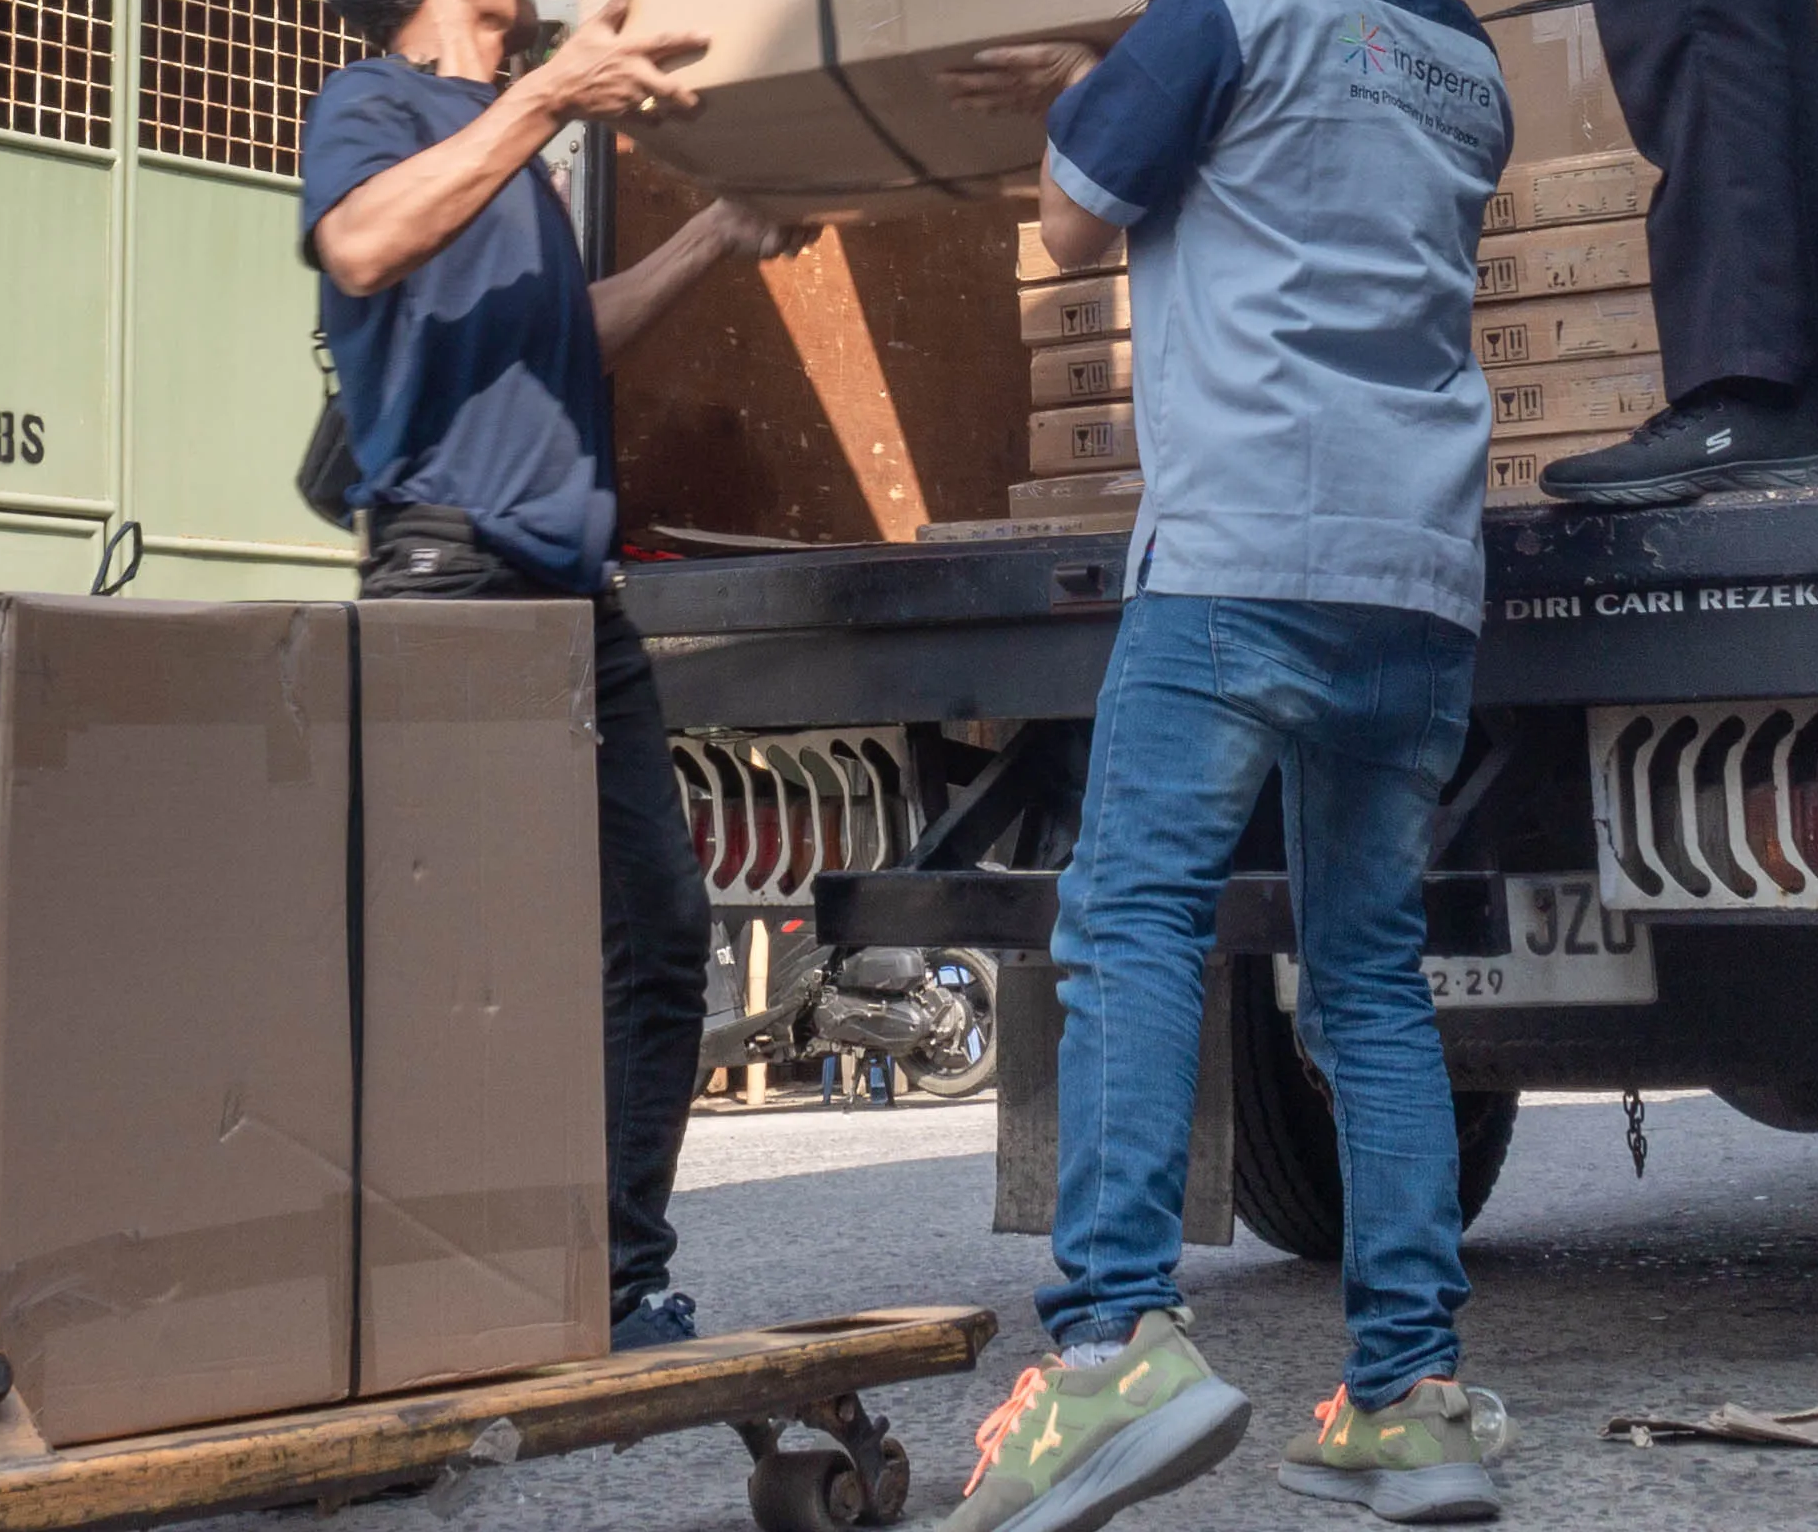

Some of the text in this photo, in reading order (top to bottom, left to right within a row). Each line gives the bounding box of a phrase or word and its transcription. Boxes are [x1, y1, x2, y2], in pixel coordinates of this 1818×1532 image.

[1392, 41, 1490, 108] insperra
[1350, 84, 1379, 105] Bring
[1505, 597, 1580, 622] DIRI
[1594, 591, 1684, 617] CARI
